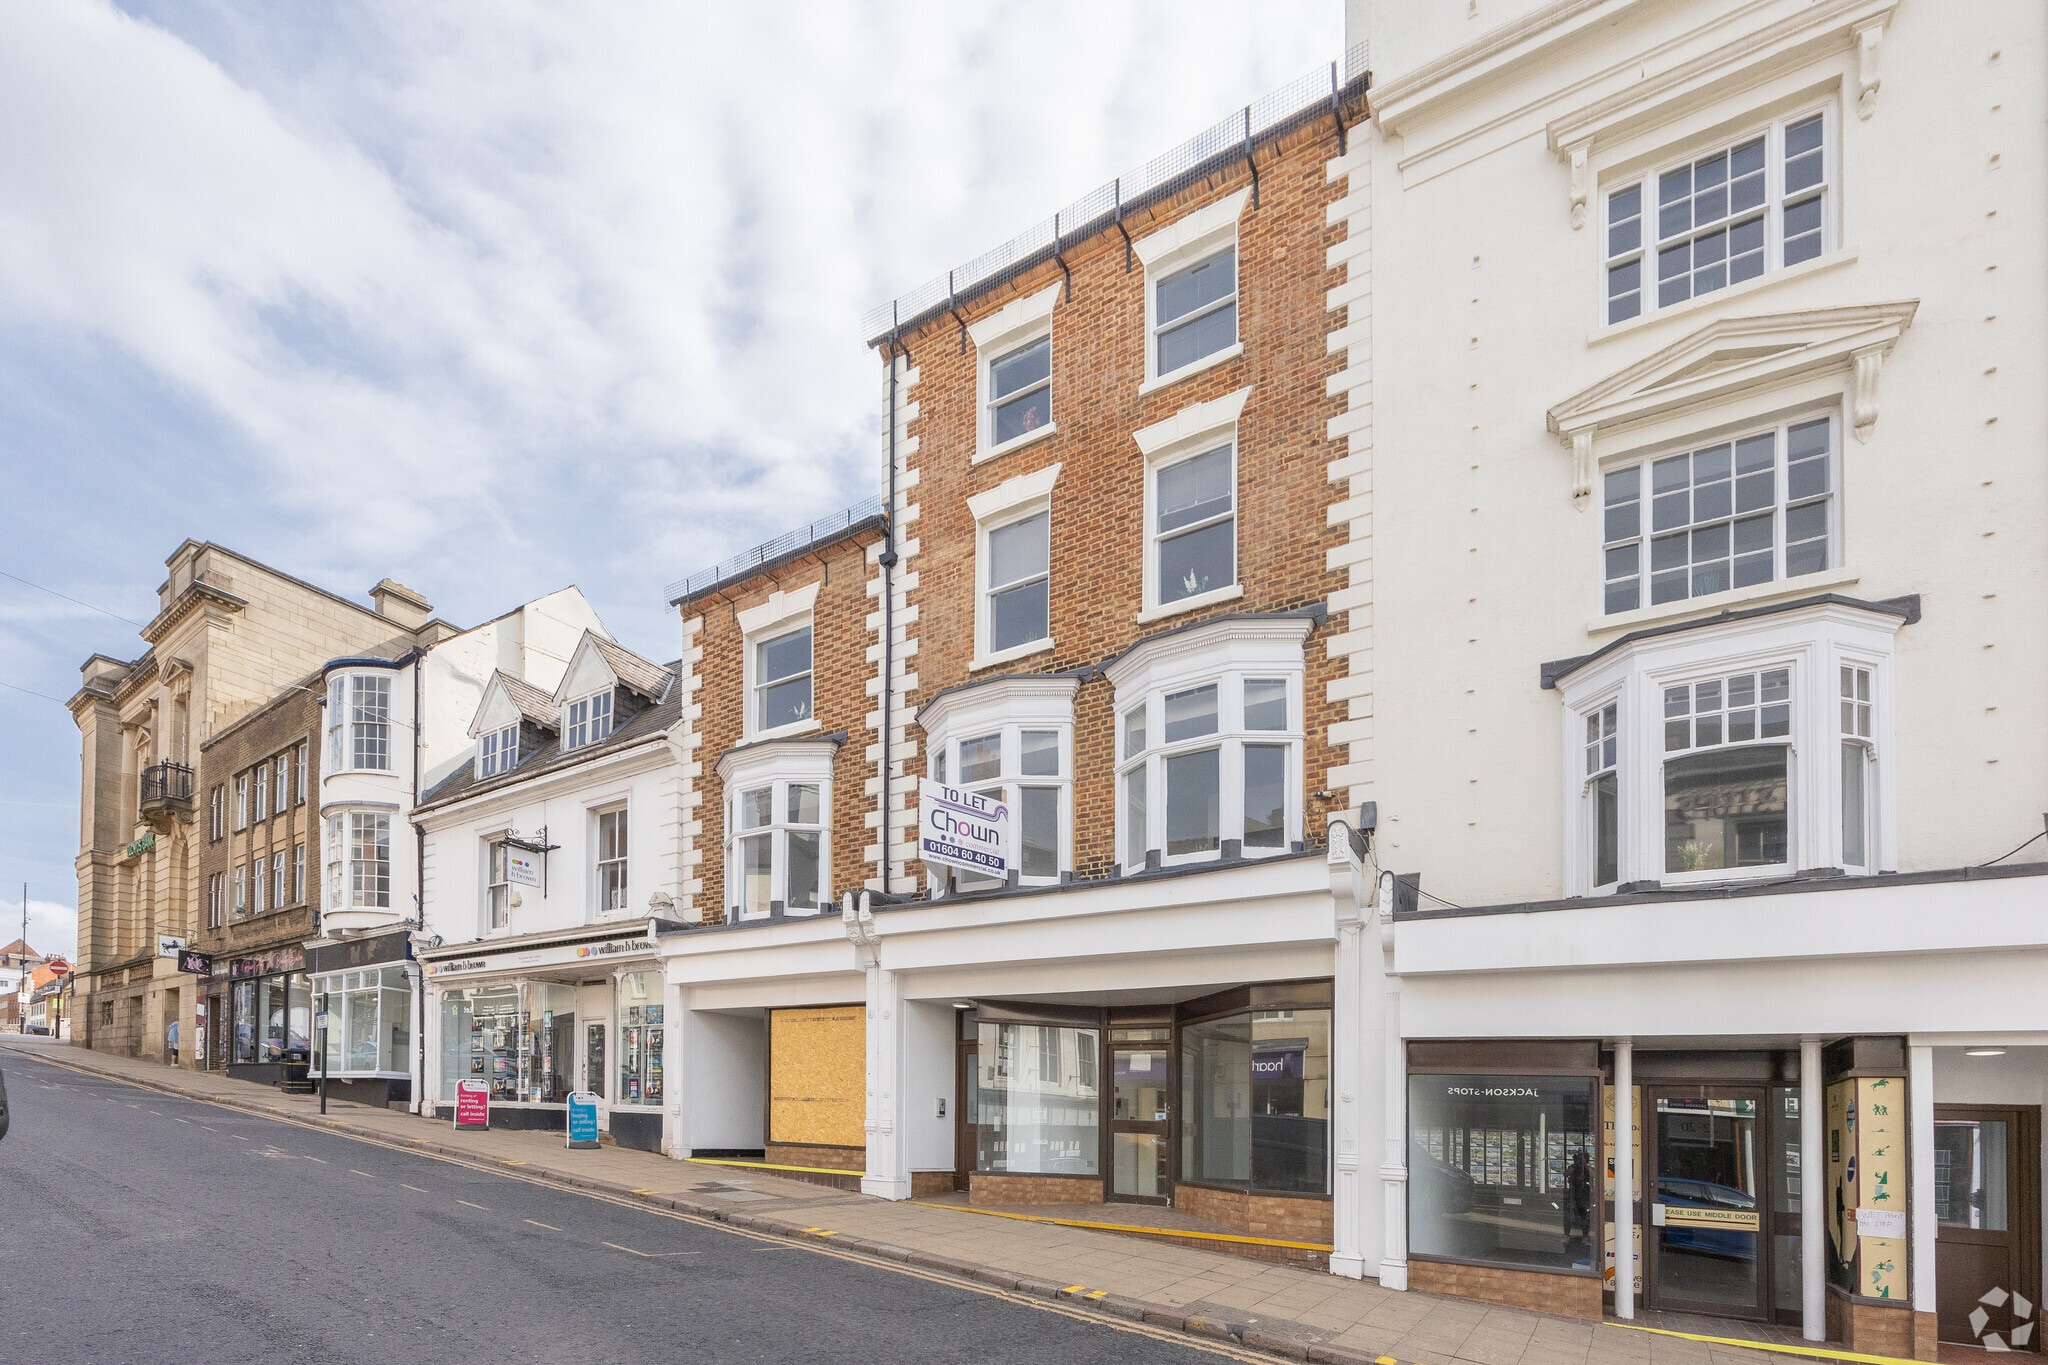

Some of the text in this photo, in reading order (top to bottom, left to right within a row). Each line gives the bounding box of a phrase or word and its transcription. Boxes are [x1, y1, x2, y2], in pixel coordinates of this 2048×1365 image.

[942, 786, 988, 811] TO LET
[931, 809, 999, 846] Chown
[929, 841, 1000, 868] 01604 60 40 50
[599, 940, 653, 954] william h brow
